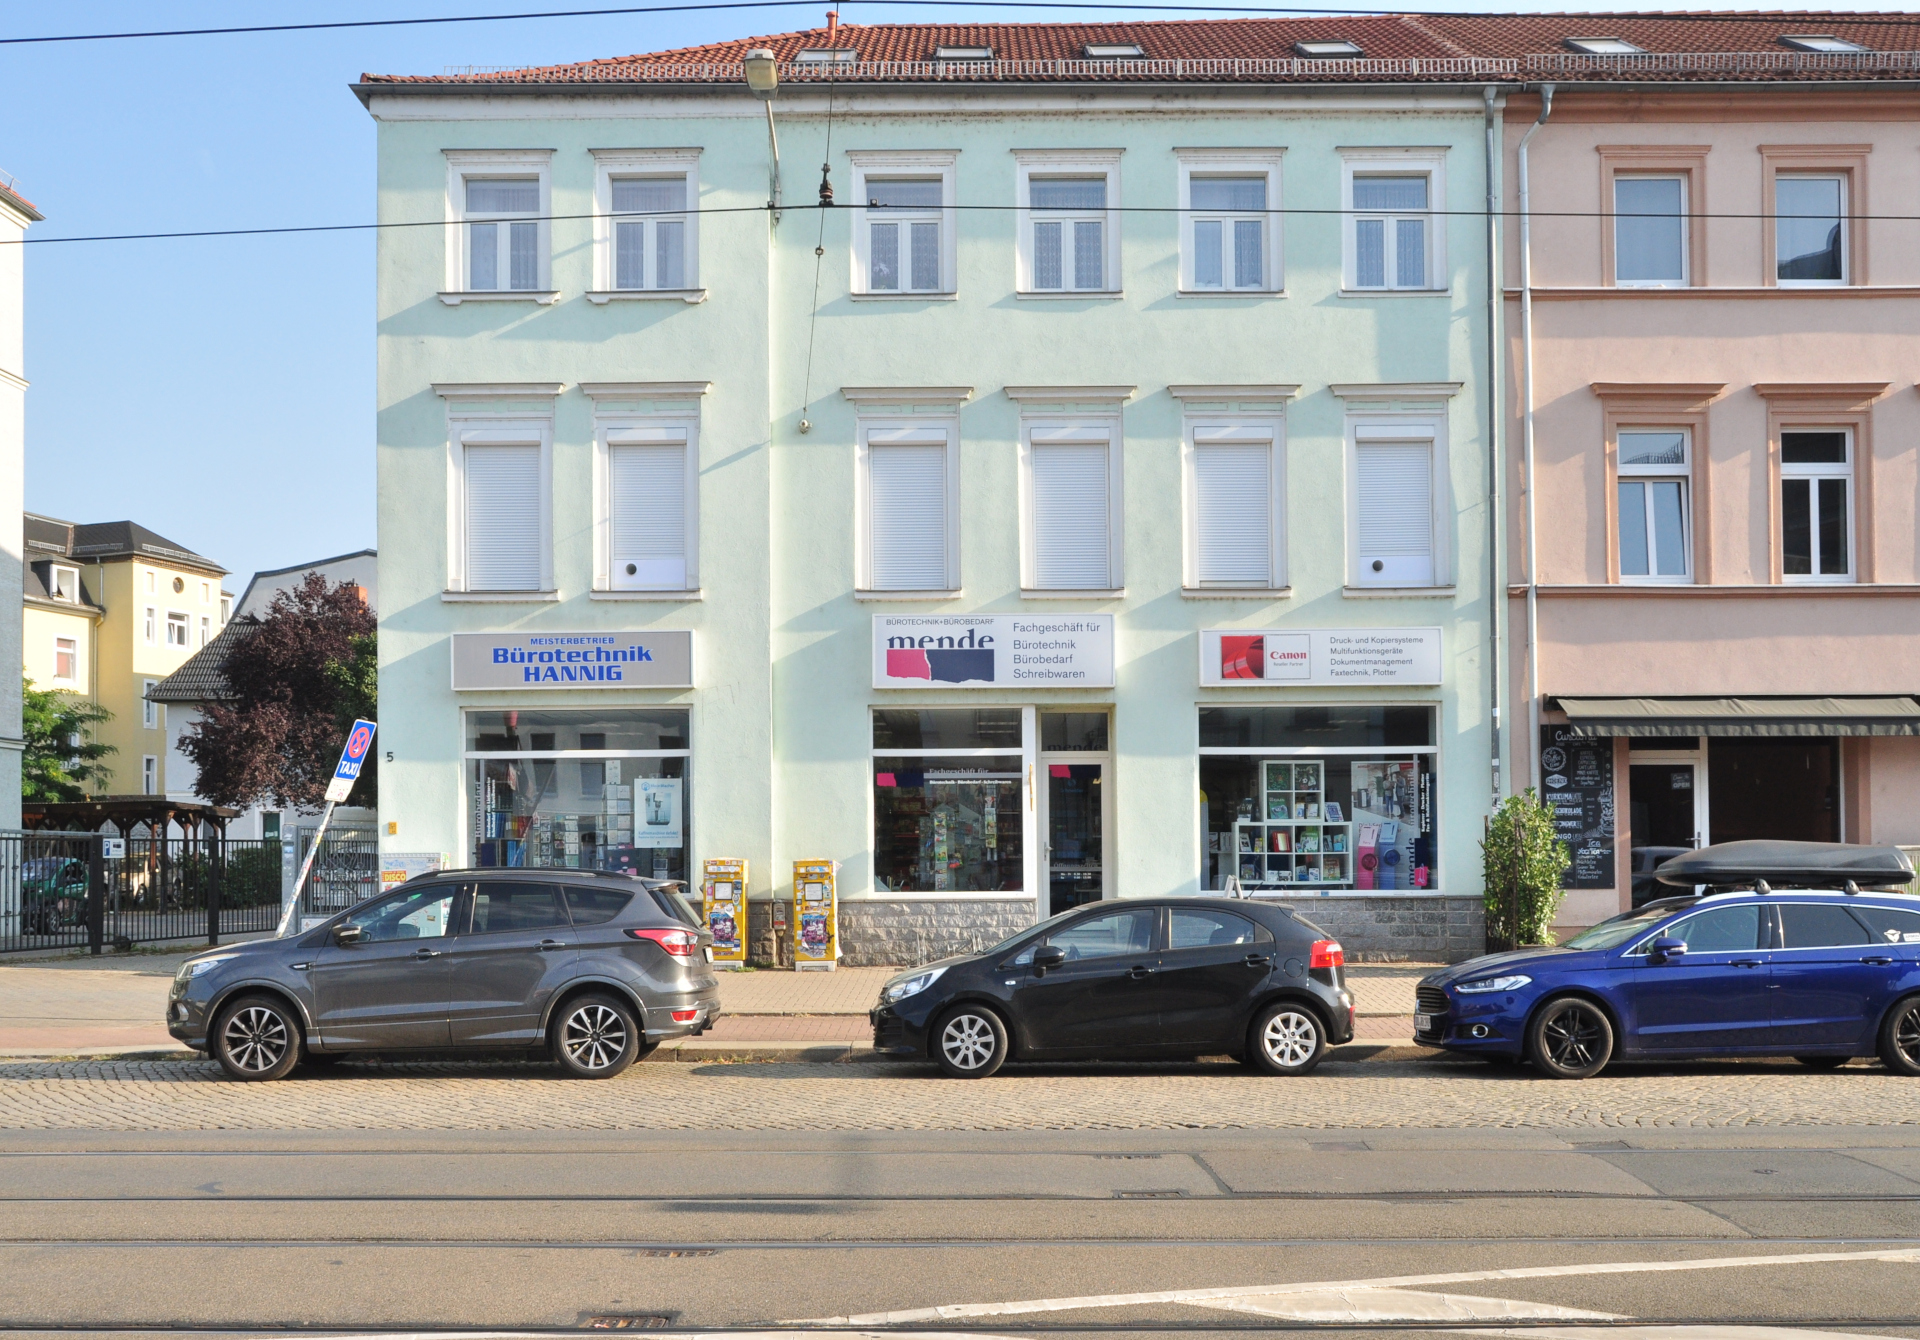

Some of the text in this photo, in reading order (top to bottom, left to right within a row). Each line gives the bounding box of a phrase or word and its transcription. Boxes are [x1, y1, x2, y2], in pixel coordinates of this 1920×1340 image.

[886, 618, 995, 626] BÜROTECHNIK+BÜROBEDARF
[1013, 622, 1100, 634] Fachgeschäft für
[530, 637, 615, 646] MEISTERBETRIEB
[886, 628, 995, 649] mende
[1371, 636, 1424, 646] Kopiersysteme
[1013, 640, 1076, 650] Bürotechnik
[492, 646, 654, 664] Bürotechnik
[1270, 651, 1307, 660] Canon
[1330, 647, 1403, 656] Multifunktionsgeräte
[1013, 654, 1073, 664] Bürobedarf
[1330, 658, 1413, 666] Dokumentmanagement
[523, 664, 623, 682] HANNIG
[1013, 668, 1085, 679] Schreibwaren
[1330, 669, 1371, 677] Faxtechnik,
[386, 752, 394, 763] 5
[340, 761, 359, 776] TAXI
[1406, 838, 1415, 886] mende
[384, 872, 406, 881] DISCO
